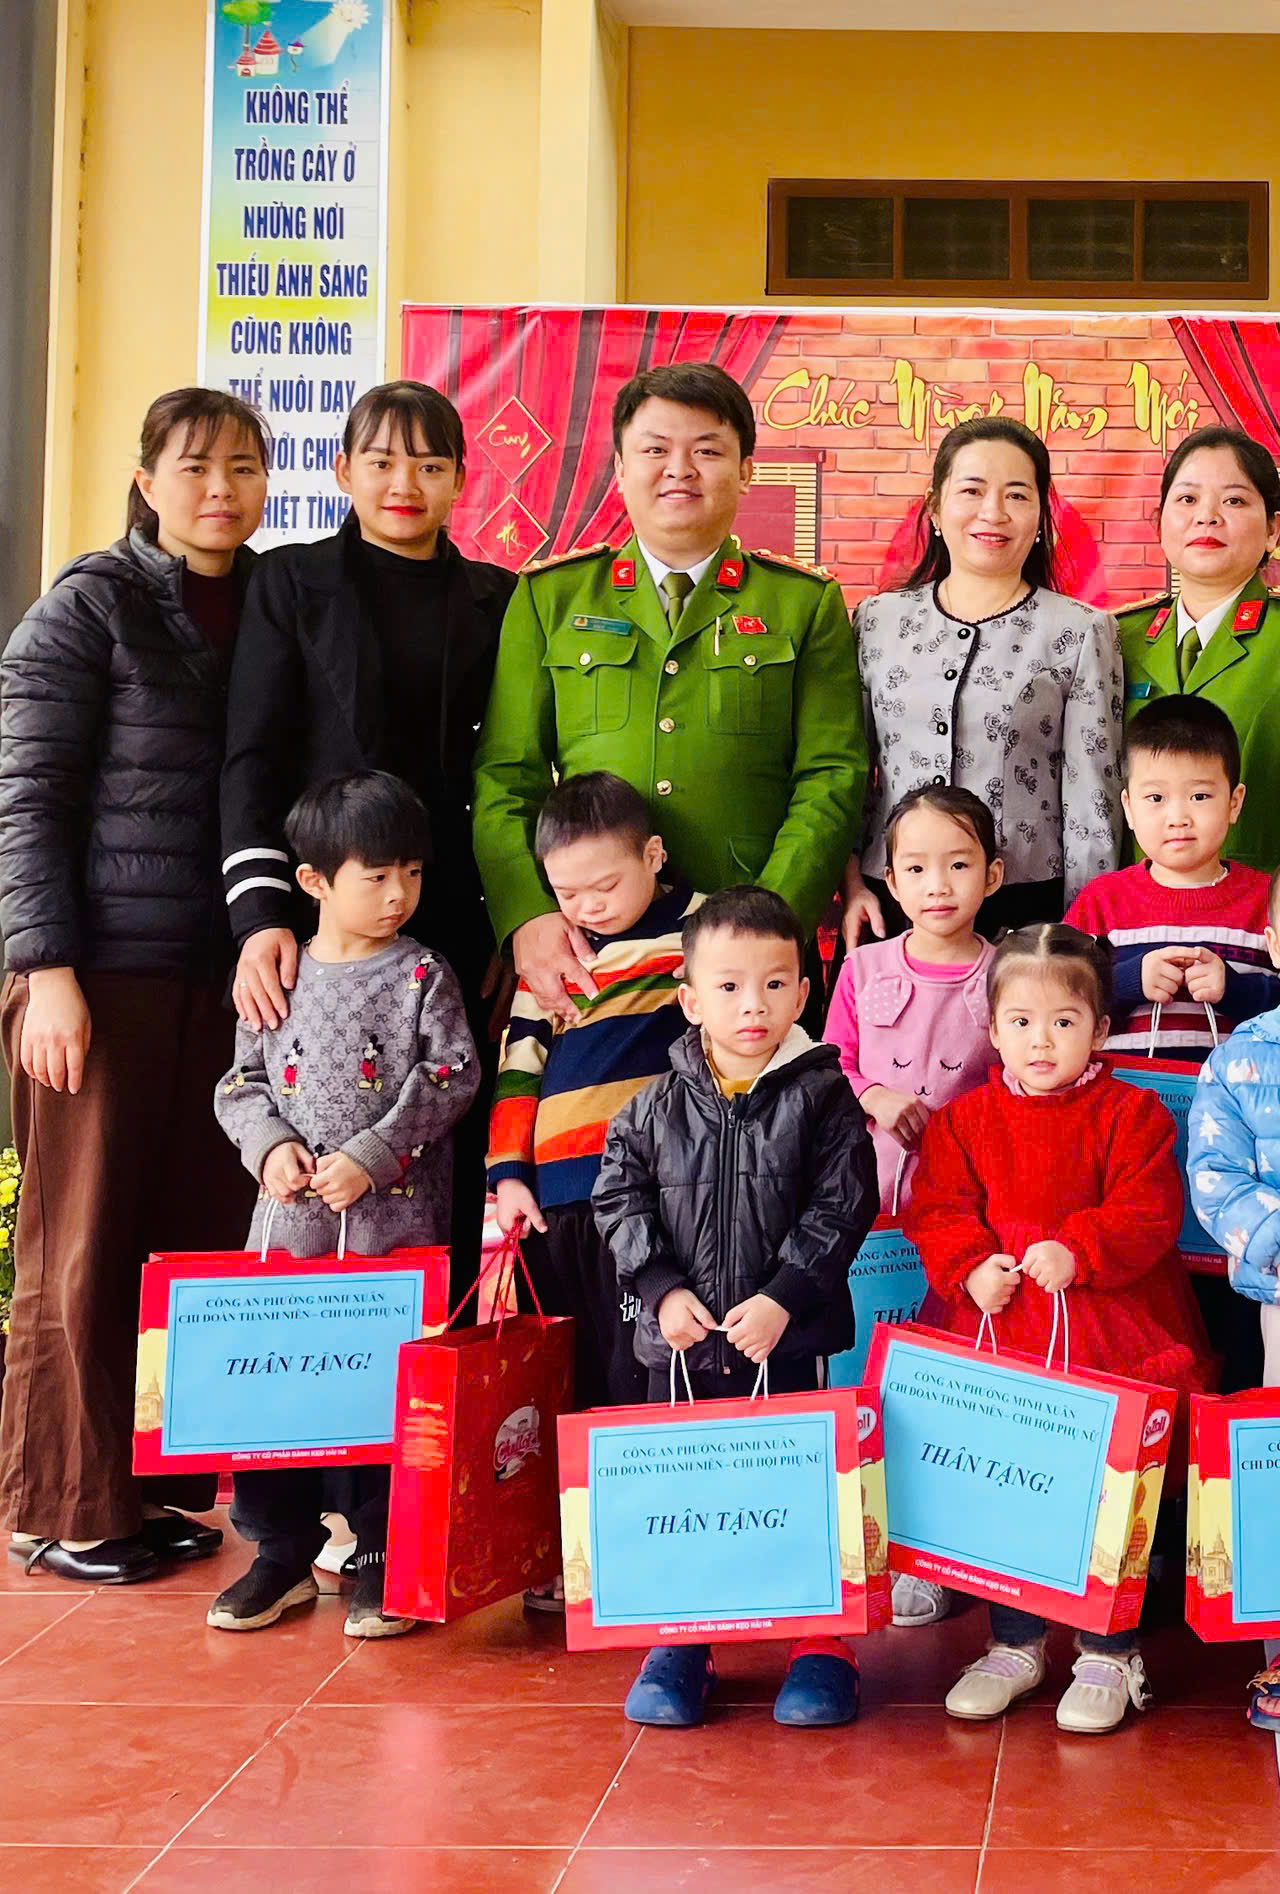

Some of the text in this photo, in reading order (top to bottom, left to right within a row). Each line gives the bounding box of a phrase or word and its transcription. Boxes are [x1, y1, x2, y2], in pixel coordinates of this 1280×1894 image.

[246, 80, 348, 124] KHÔNG THỂ
[235, 137, 356, 182] TRỒNG CÂY Ở
[244, 201, 344, 239] NHỮNG NƠI
[216, 252, 367, 297] THIẾU ÁNH SÁNG
[231, 316, 351, 355] CŨNG KHÔNG
[270, 374, 313, 412] NUÔI
[321, 380, 356, 419] DẠY
[762, 367, 875, 430] Chúc
[1022, 361, 1107, 444] Năm
[1125, 361, 1198, 459] Mới
[303, 432, 340, 471] CHÚ
[260, 490, 350, 535] HIỆT TÌNH
[873, 1302, 918, 1324] THÂ
[227, 1351, 372, 1376] THÂN TẶNG!
[919, 1442, 1054, 1495] THÂN TẶNG!
[646, 1507, 788, 1536] THÂN TẶNG!
